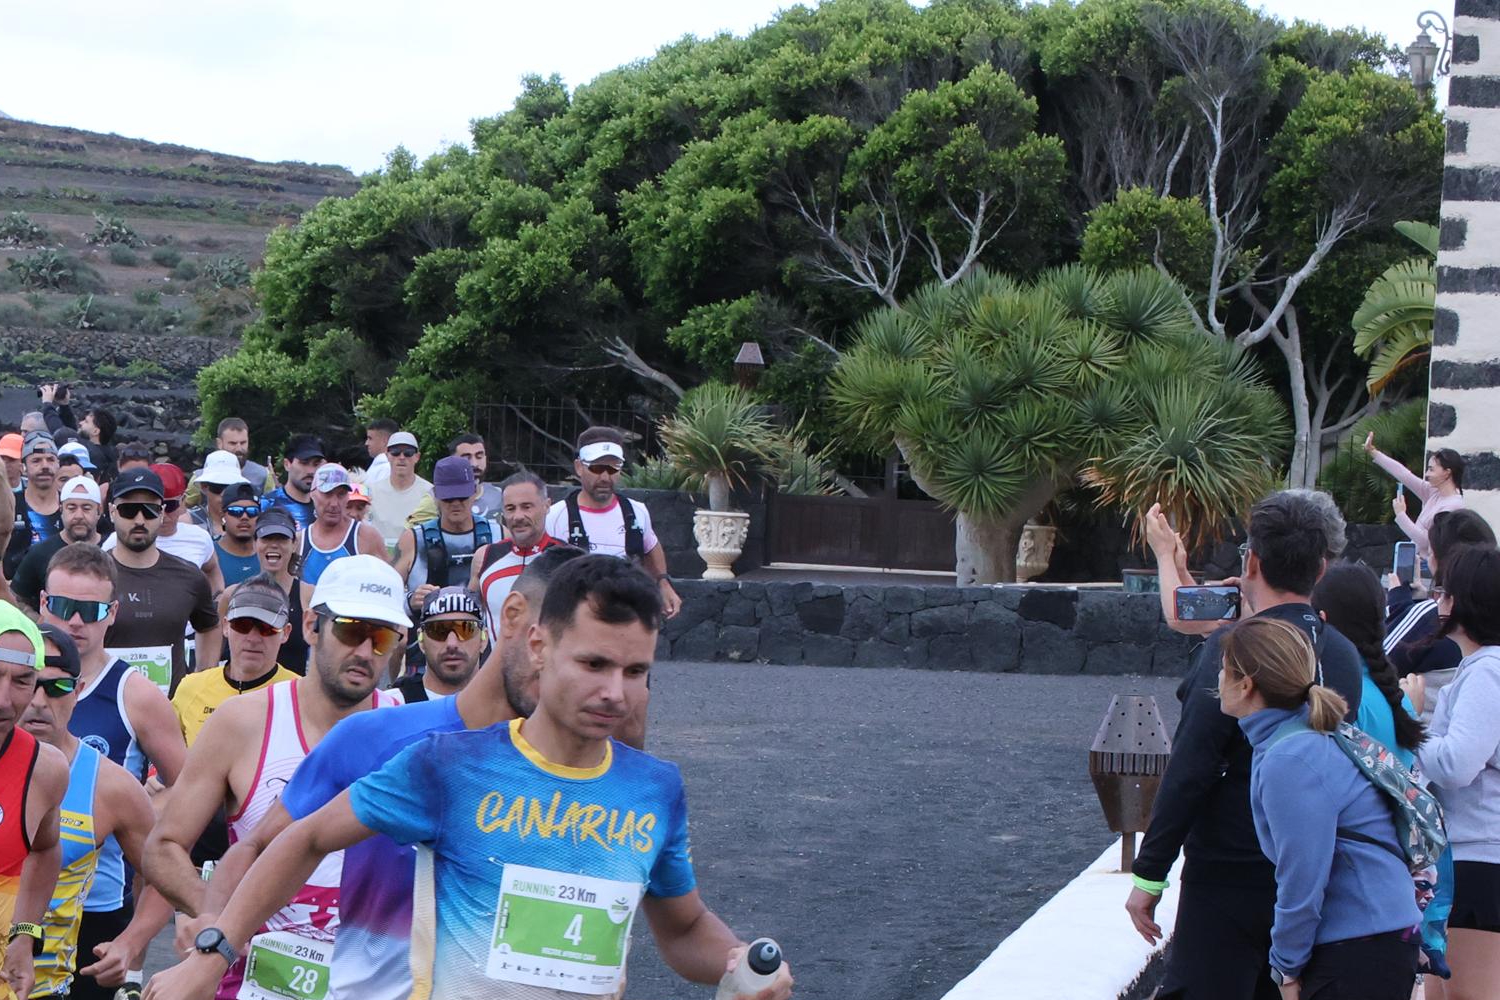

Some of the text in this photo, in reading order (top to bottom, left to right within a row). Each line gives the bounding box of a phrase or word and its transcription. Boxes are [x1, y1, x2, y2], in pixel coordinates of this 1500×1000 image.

[360, 583, 392, 597] HOKA
[476, 790, 657, 854] CANARIAS
[512, 879, 597, 903] RUNNING 23 Km
[563, 913, 584, 946] 4
[260, 936, 325, 962] RUNNING 23 Km
[288, 965, 319, 994] 28
